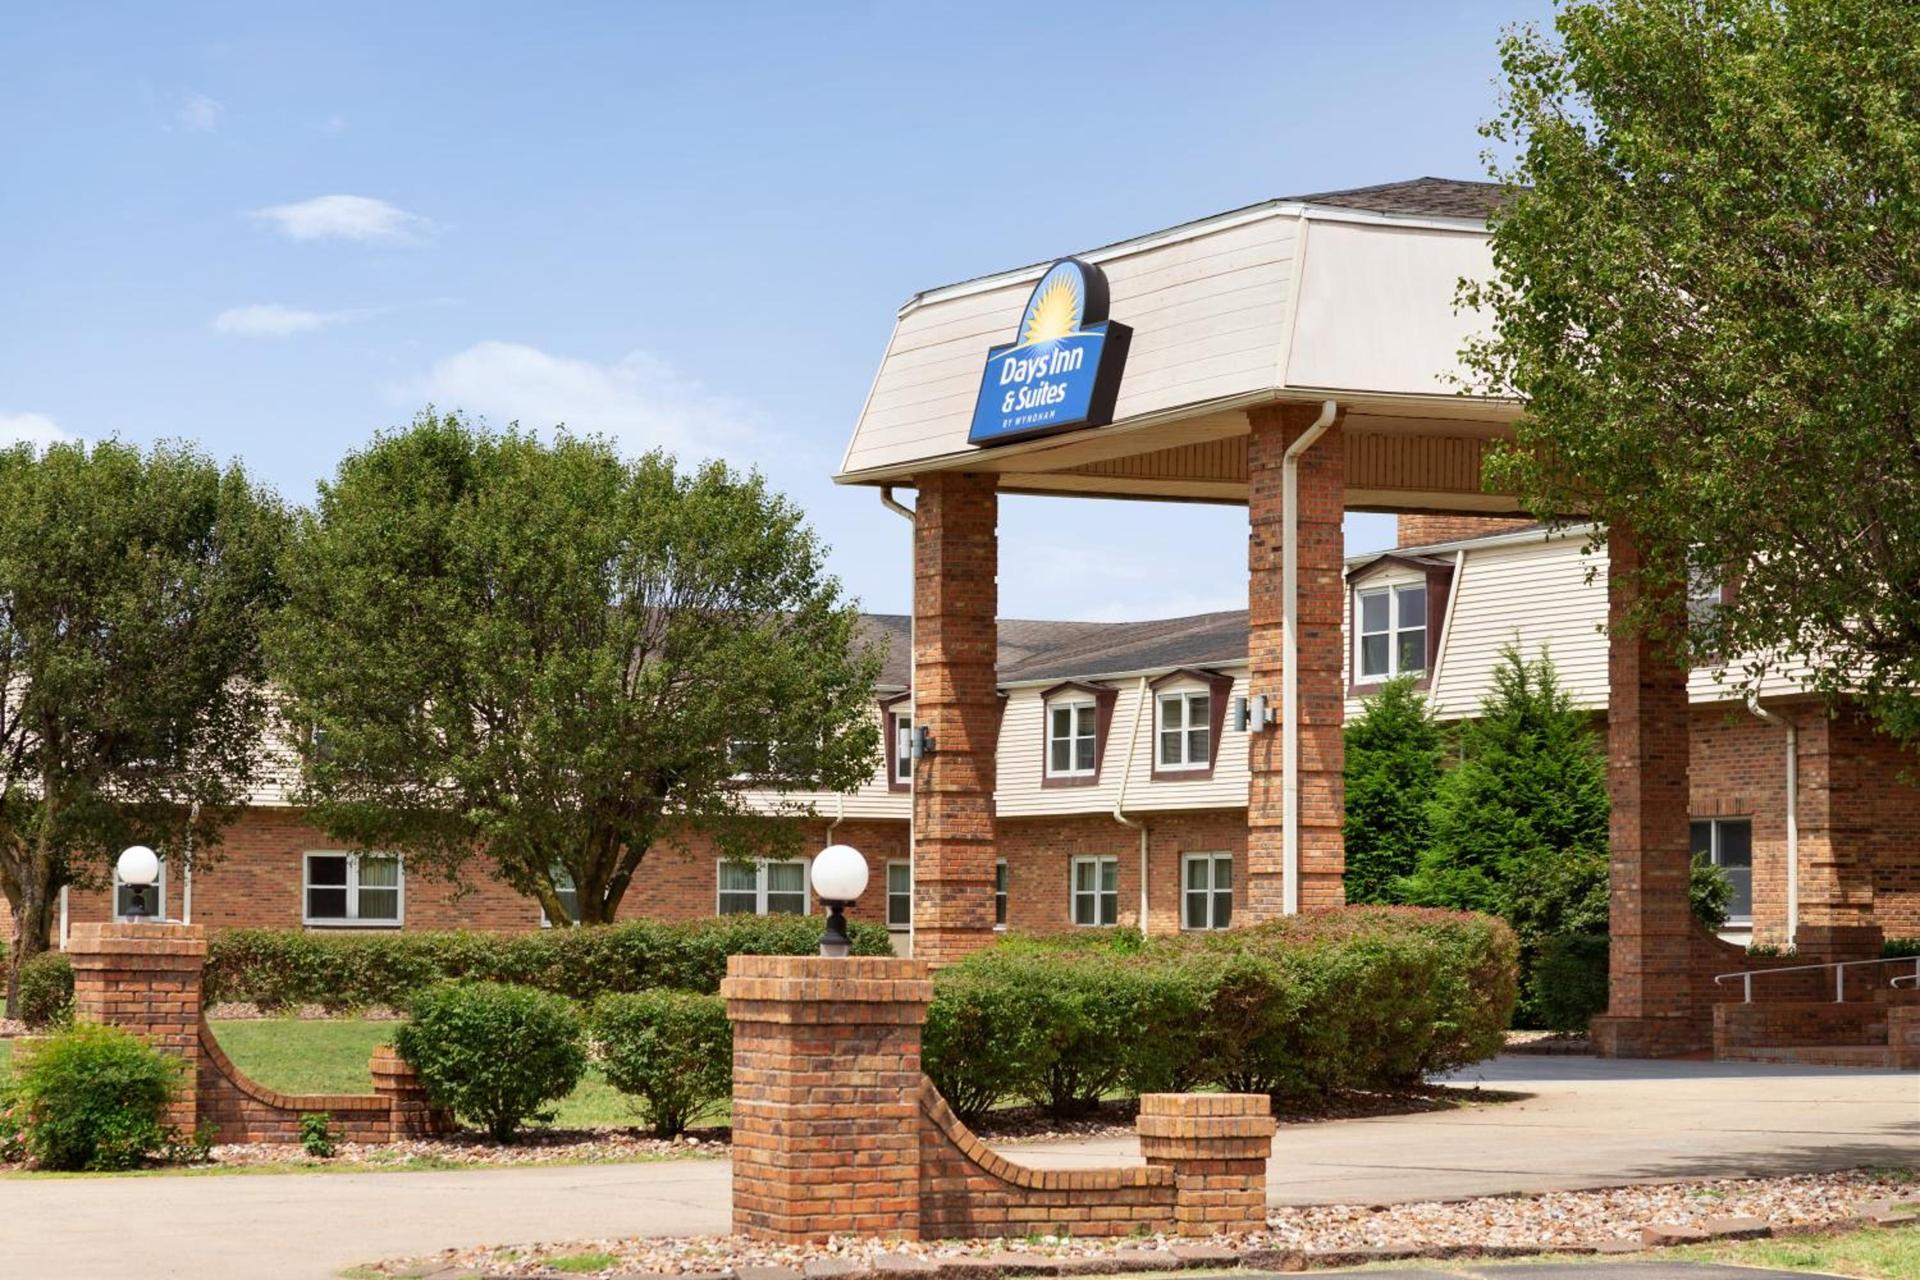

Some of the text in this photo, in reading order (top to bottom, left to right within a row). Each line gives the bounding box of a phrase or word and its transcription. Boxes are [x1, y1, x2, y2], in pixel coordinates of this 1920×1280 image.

[1000, 346, 1084, 385] Days Inn
[1002, 381, 1068, 413] & Suites
[1002, 410, 1056, 428] BY WYNDHAM
